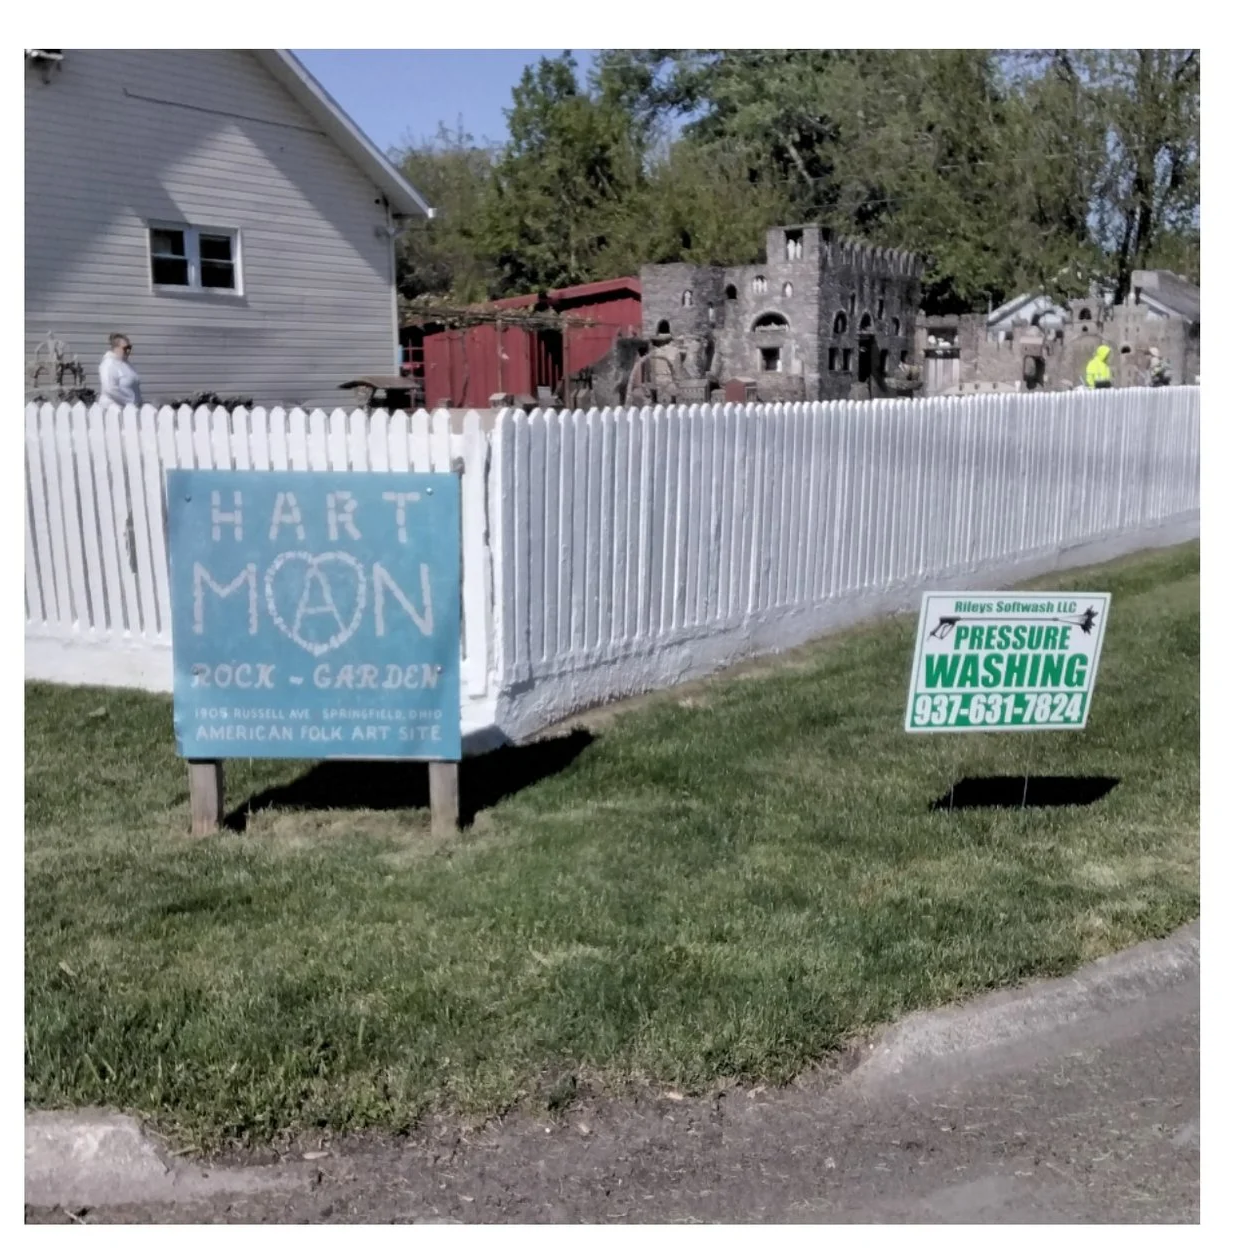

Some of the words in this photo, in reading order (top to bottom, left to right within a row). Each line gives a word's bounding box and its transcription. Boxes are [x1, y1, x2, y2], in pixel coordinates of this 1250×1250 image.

[211, 490, 420, 542] HART
[955, 601, 993, 613] Rileys
[996, 601, 1054, 613] Softwash
[1057, 601, 1076, 613] LLC
[954, 625, 1072, 650] PRESSURE
[190, 663, 276, 688] ROCK
[313, 664, 440, 688] GARDEN
[925, 653, 1089, 688] WASHING
[194, 707, 228, 719] 1905
[234, 708, 284, 719] RUSSELL
[289, 710, 310, 719] AVE
[410, 710, 442, 719] OHIO
[914, 693, 1083, 725] 937-631-7824
[196, 726, 292, 740] AMERICAN
[302, 726, 342, 740] FOLK
[352, 726, 390, 740] ART
[400, 726, 442, 740] SITE
